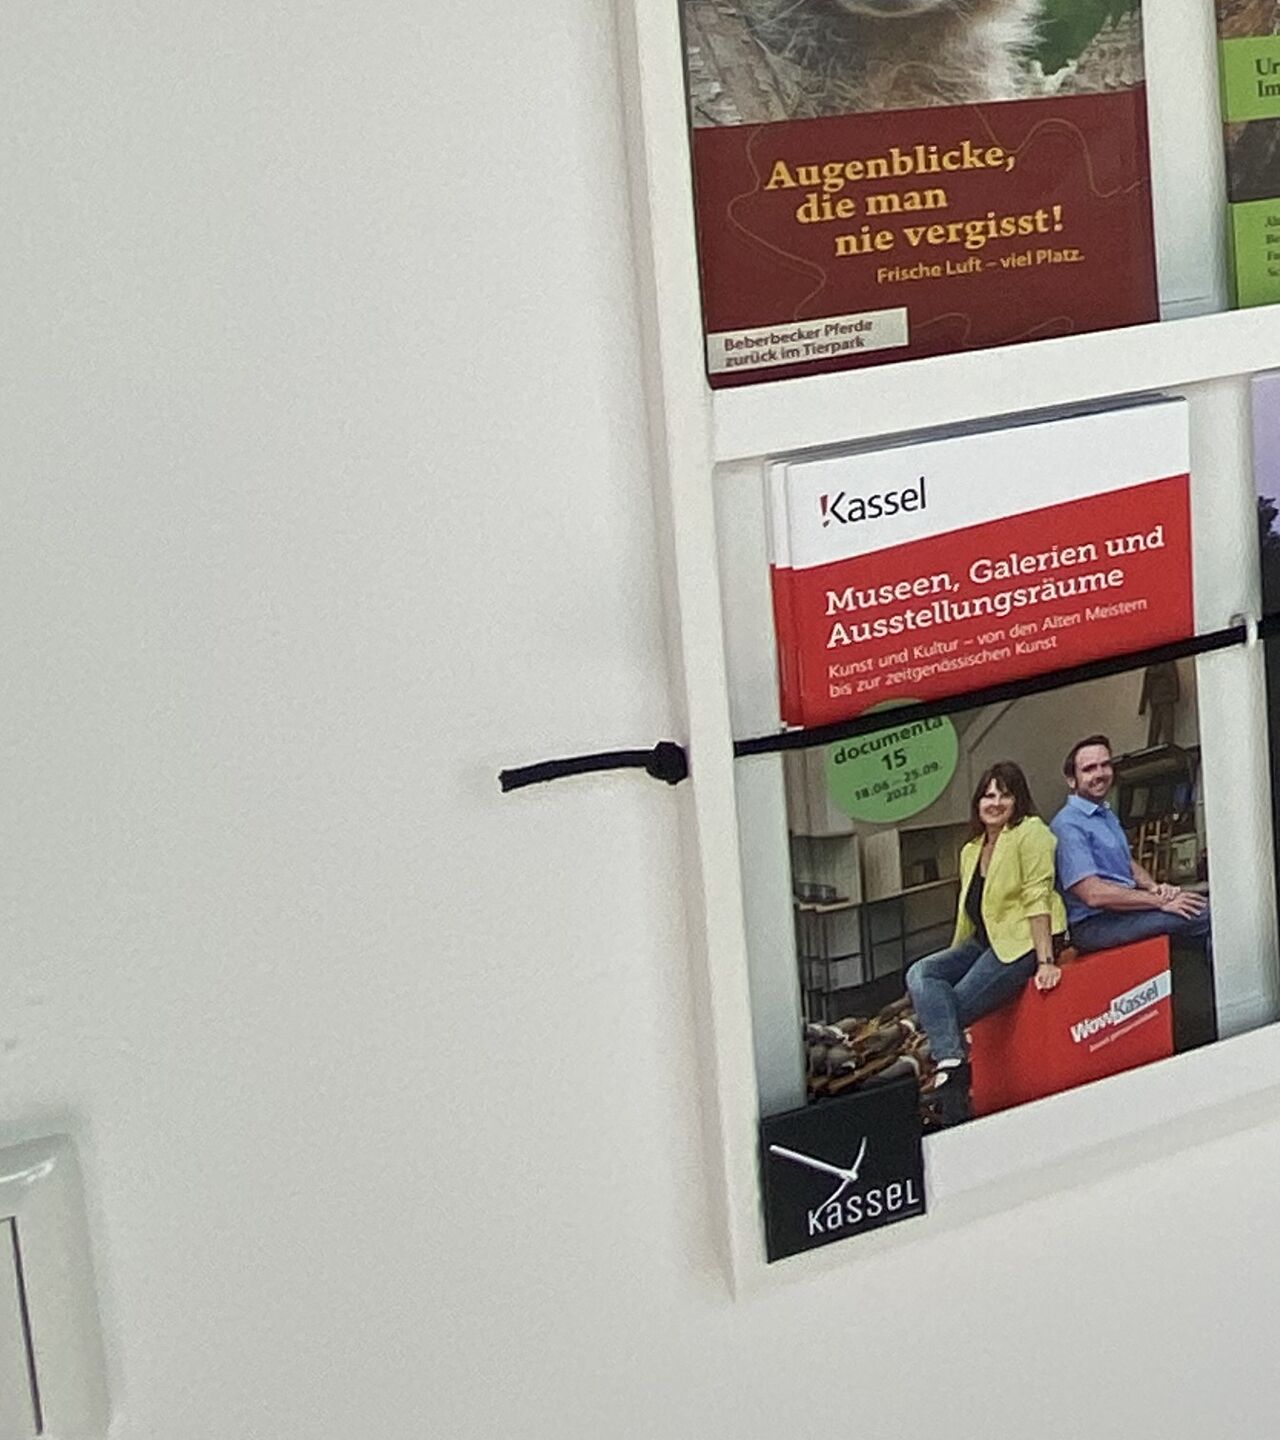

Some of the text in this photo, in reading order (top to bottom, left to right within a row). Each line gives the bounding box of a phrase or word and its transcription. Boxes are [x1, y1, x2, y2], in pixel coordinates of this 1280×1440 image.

[764, 140, 1016, 193] Augenblicke,
[795, 187, 949, 225] die man
[834, 204, 1065, 257] nie vergisst!
[876, 245, 1086, 285] Frische Luft viel Platz.
[723, 319, 873, 353] Beberbecker Pferde
[724, 335, 866, 369] zurück im Tierpark
[819, 475, 927, 529] Kassel
[824, 525, 1166, 617] Museen, Galerien und
[826, 567, 1125, 650] Ausstellungsräume
[828, 596, 1148, 678] Kunst und Kultur von den Alten Meistern
[829, 635, 1058, 698] bis zur zeitgenössischen Kunst
[833, 715, 943, 765] documenta
[880, 748, 908, 771] 15
[886, 782, 918, 803] 2022
